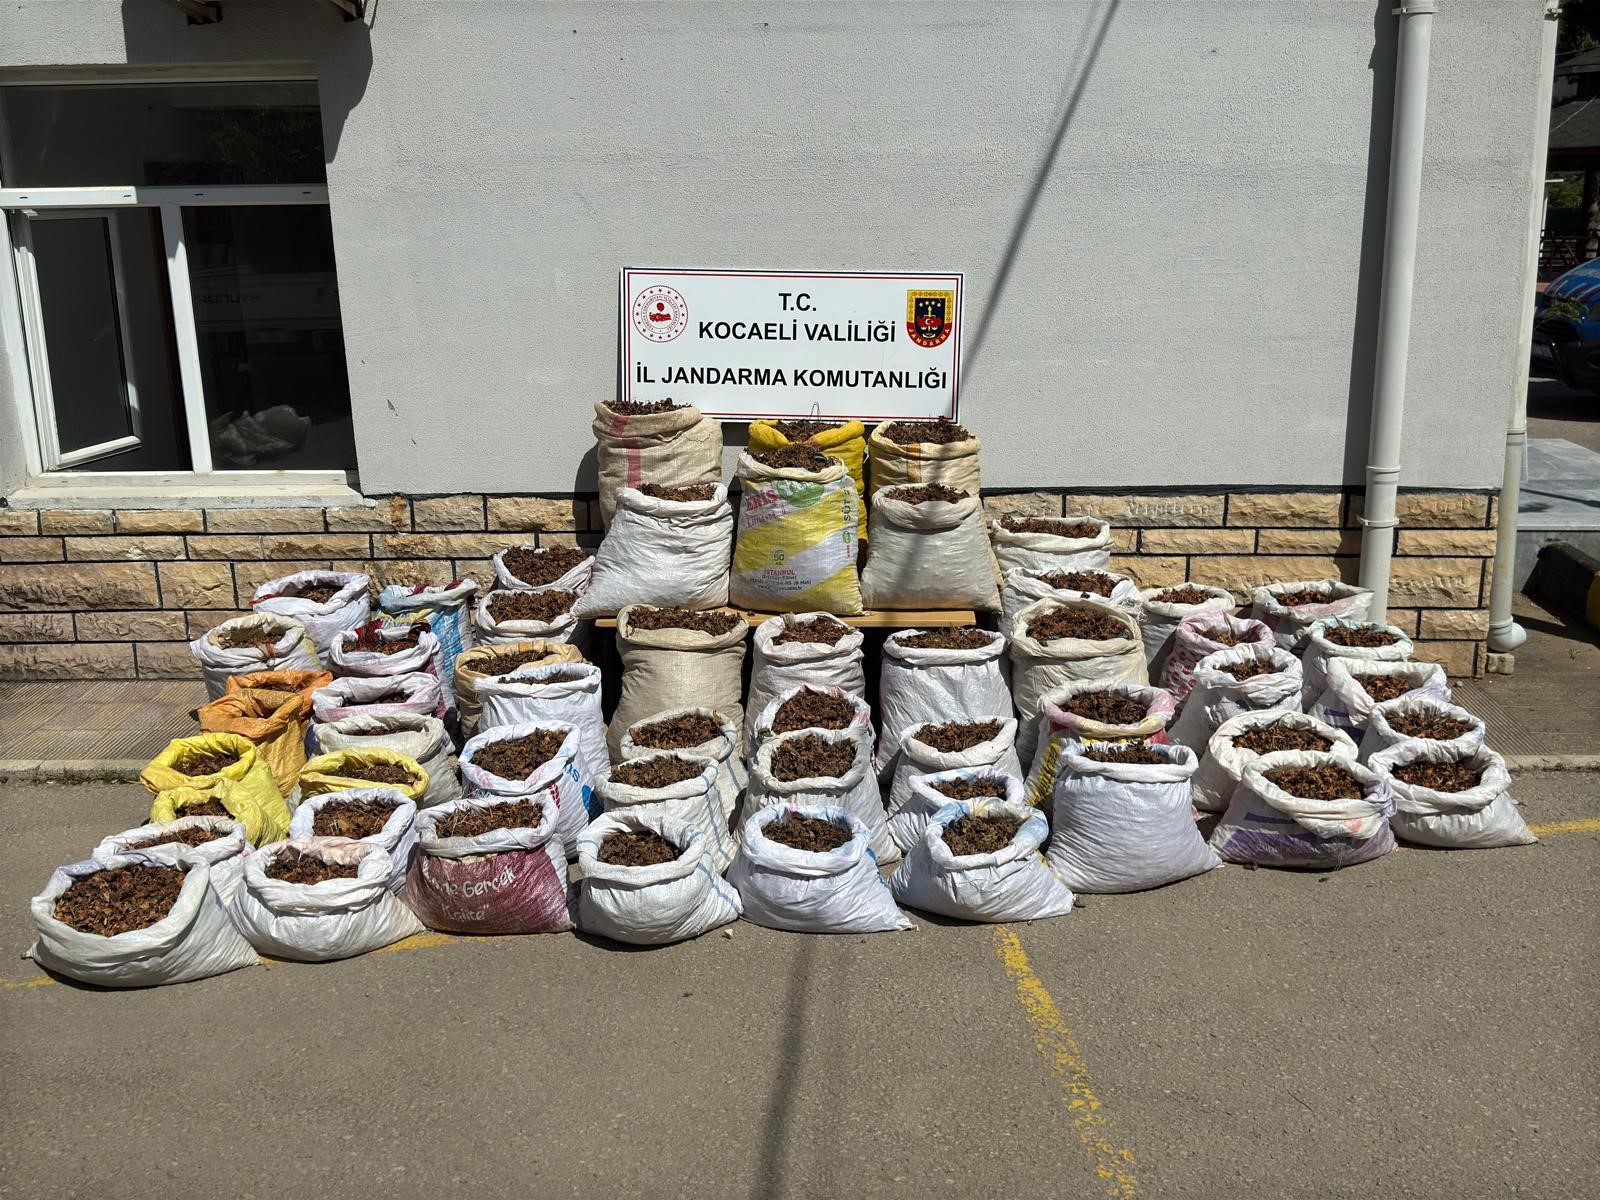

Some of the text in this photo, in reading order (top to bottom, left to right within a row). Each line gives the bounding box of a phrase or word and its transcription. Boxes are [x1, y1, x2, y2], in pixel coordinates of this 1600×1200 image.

[779, 292, 817, 312] T.C.
[699, 319, 896, 342] KOCAELİ VALİLİĞİ
[908, 328, 950, 346] JANDARMA
[636, 361, 947, 389] İL JANDARMA KOMUTANLIĞI
[463, 865, 517, 898] Gerçek
